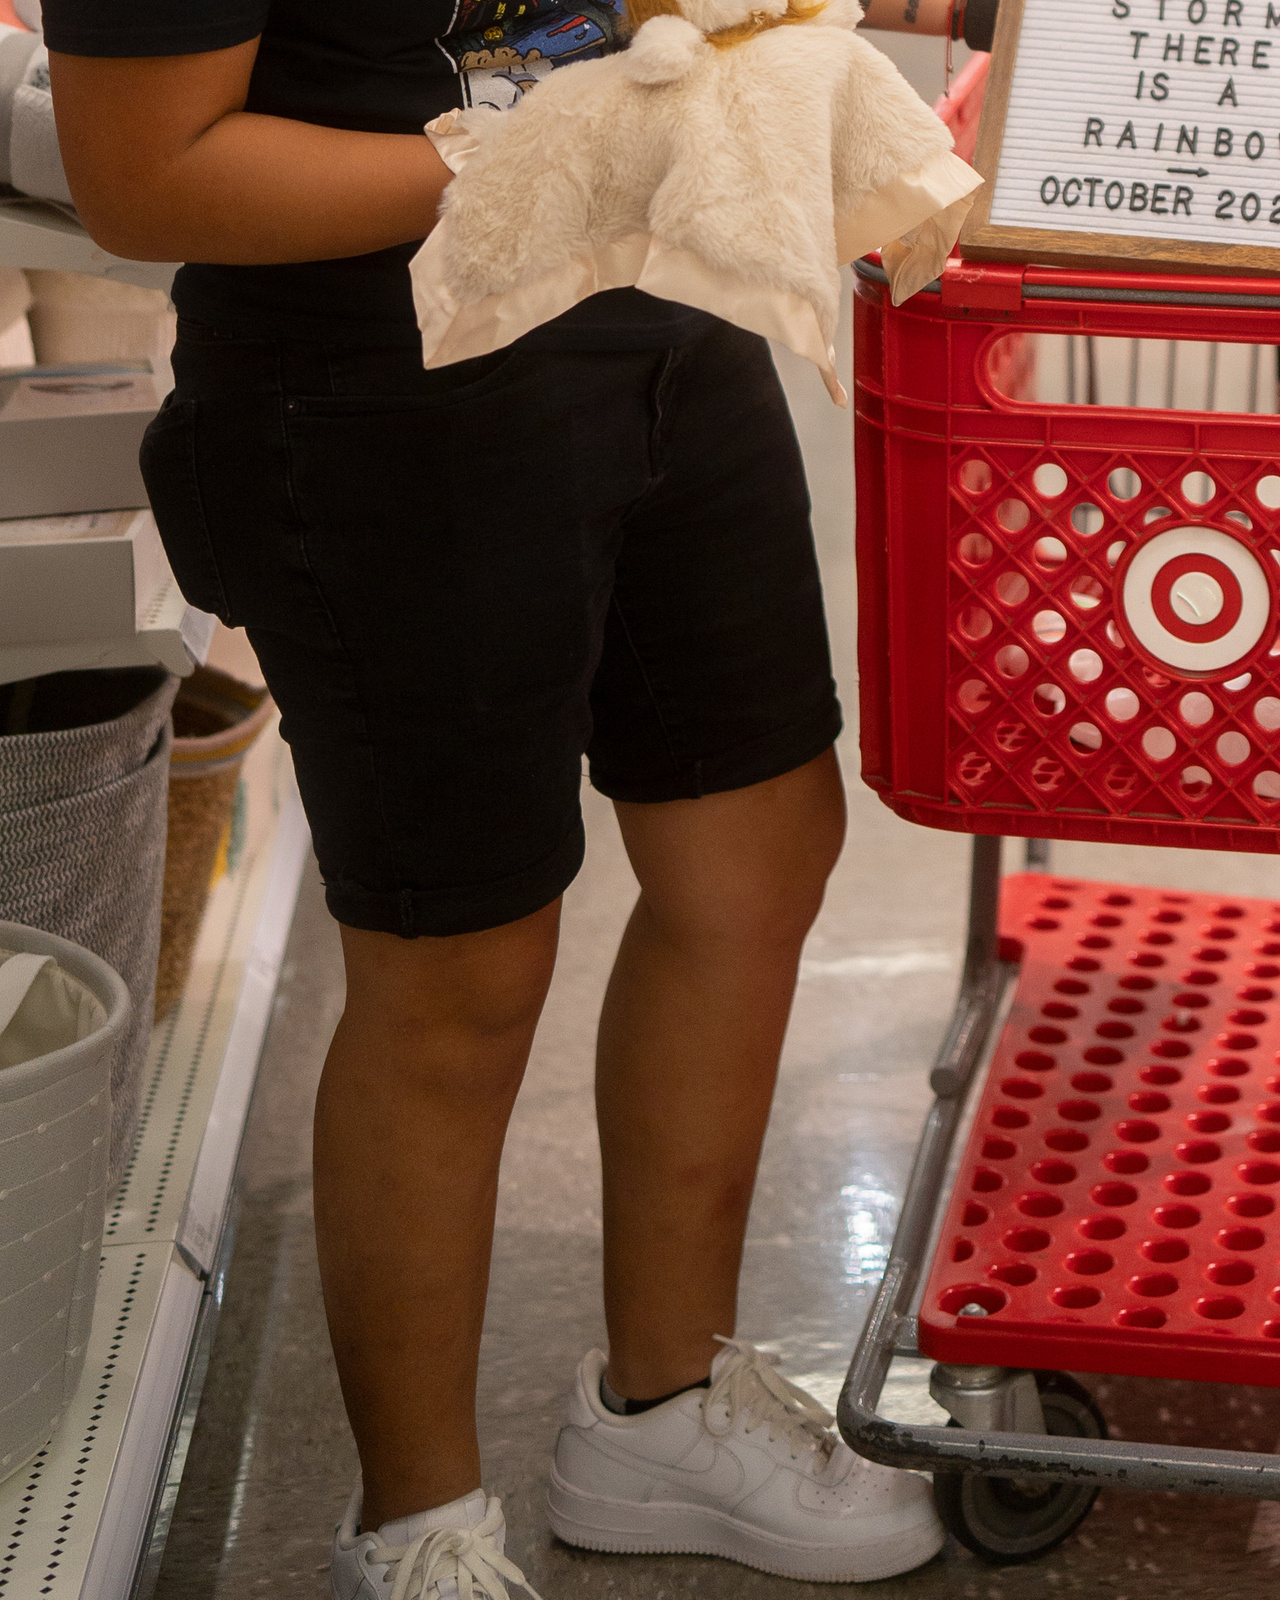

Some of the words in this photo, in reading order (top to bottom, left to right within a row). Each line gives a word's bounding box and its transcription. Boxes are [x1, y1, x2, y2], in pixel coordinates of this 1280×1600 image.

[1130, 30, 1272, 69] THERE
[1134, 70, 1170, 101] IS
[1217, 75, 1239, 107] A
[1040, 175, 1194, 216] OCTOBER
